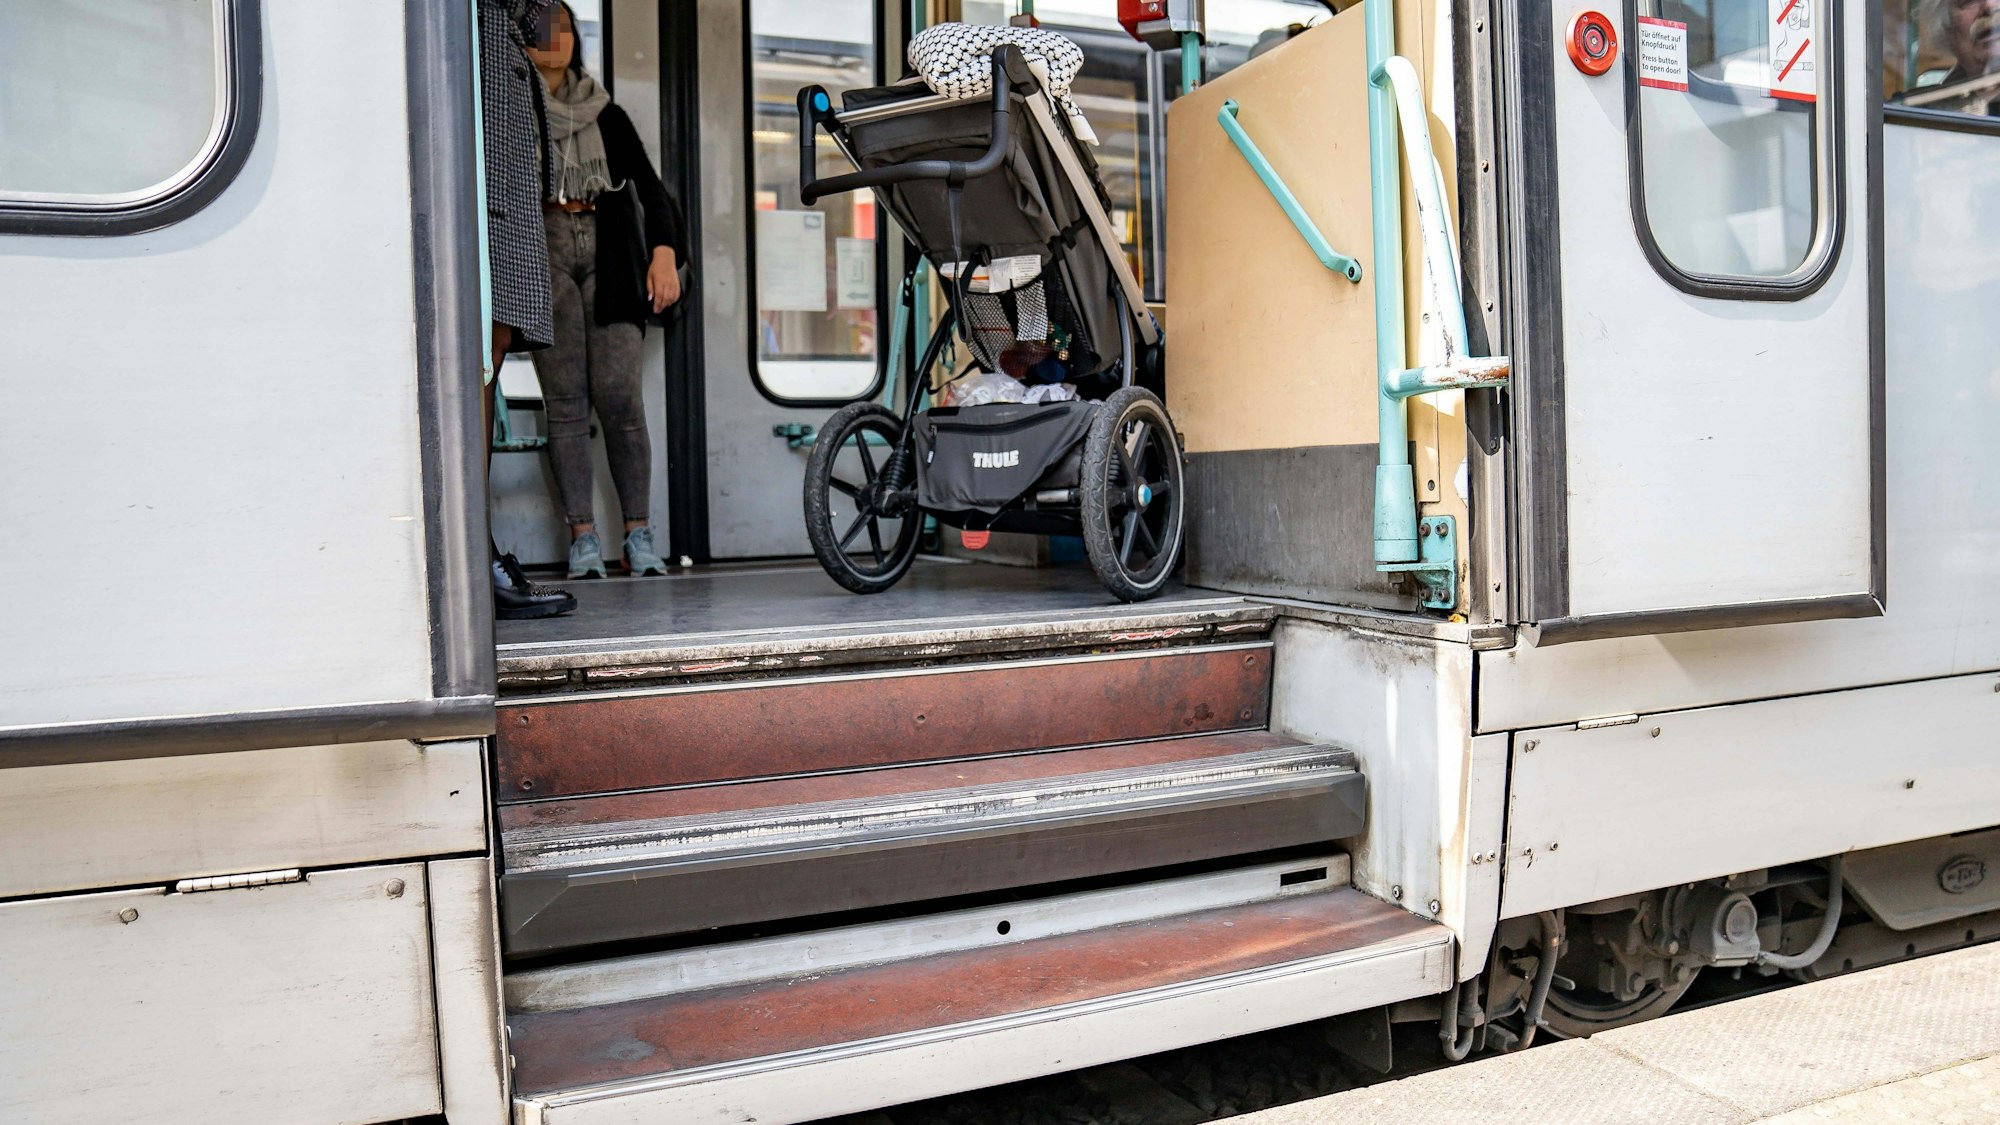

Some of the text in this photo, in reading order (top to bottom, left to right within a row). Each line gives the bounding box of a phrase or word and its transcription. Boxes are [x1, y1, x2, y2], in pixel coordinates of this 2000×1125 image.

[1652, 32, 1670, 40] öffnet
[1642, 40, 1677, 50] Knopfdruck!
[1642, 54, 1678, 65] Press button
[1650, 65, 1664, 73] open
[972, 450, 1019, 468] THULE
